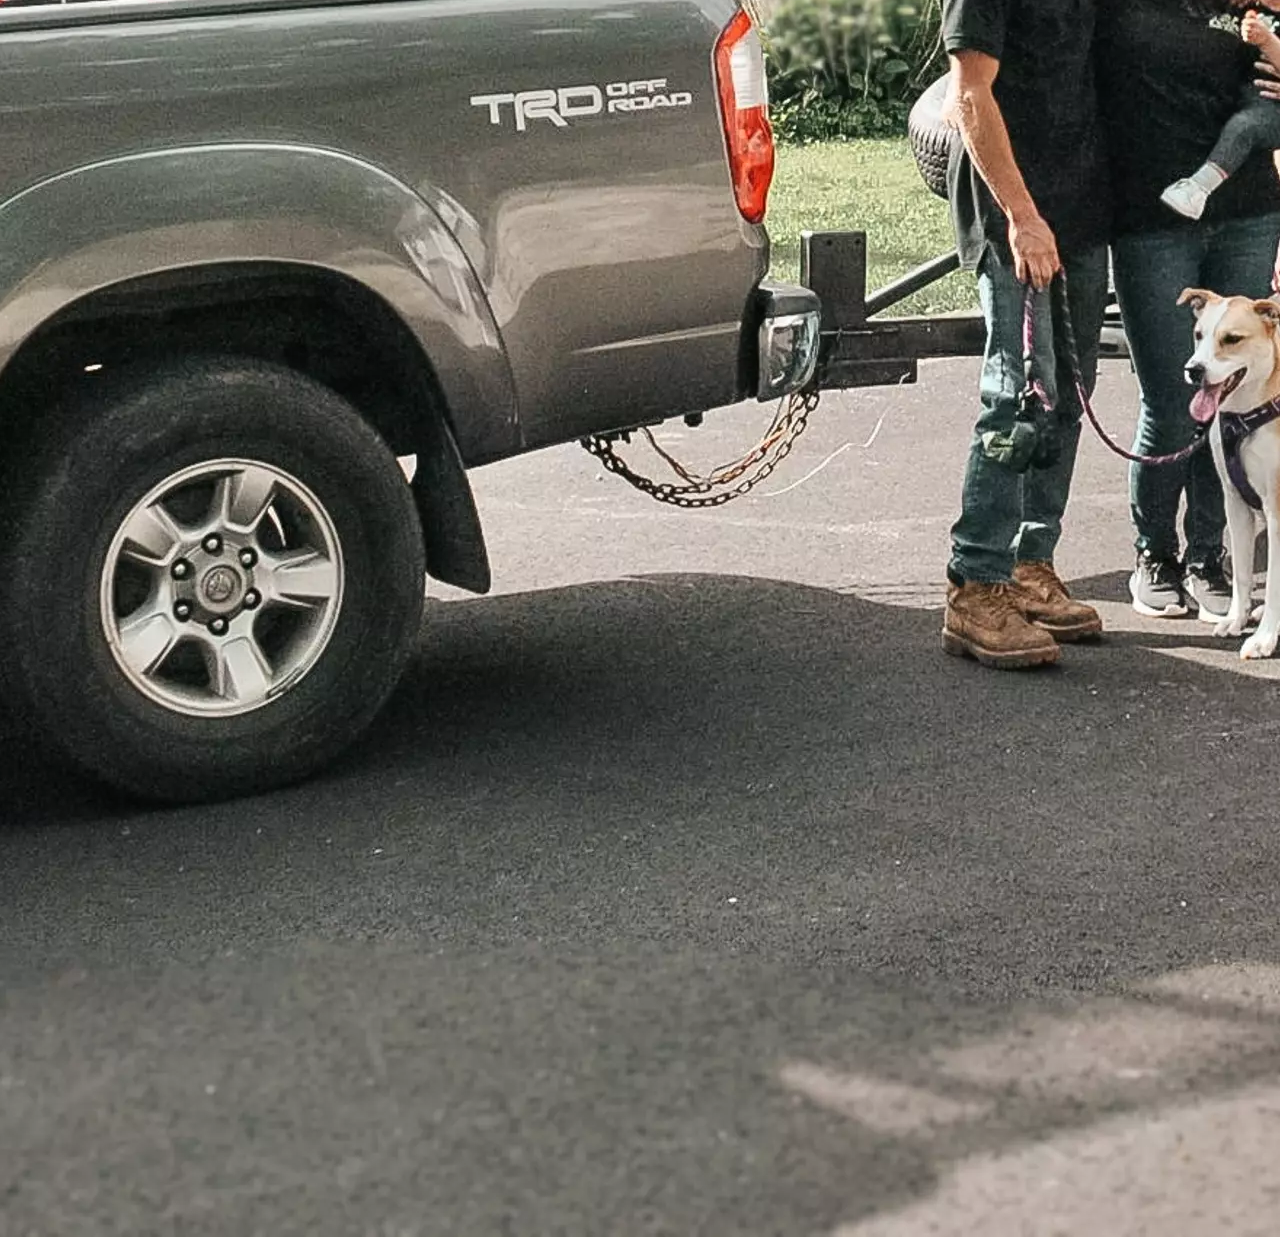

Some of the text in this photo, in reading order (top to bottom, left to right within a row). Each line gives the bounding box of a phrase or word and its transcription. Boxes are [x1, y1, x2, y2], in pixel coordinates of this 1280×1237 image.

[605, 77, 669, 96] OFF
[470, 84, 603, 131] TRD
[607, 91, 692, 113] ROAD
